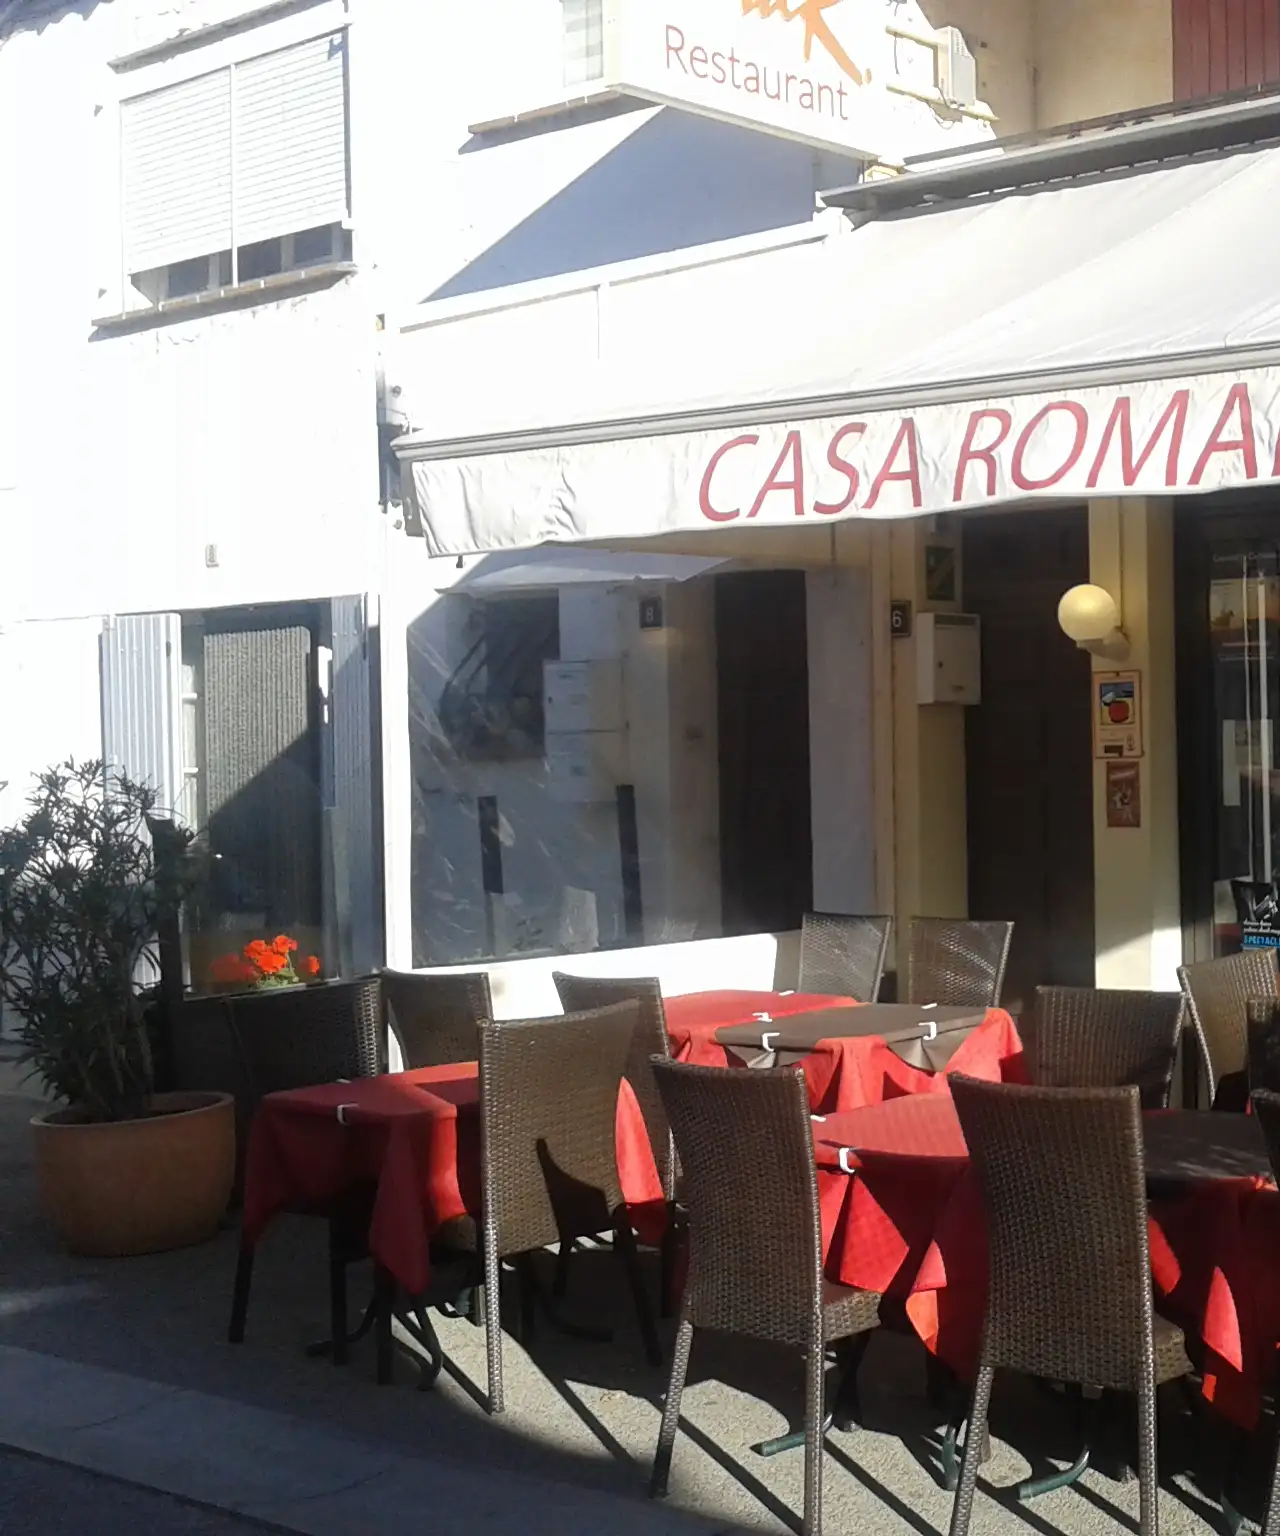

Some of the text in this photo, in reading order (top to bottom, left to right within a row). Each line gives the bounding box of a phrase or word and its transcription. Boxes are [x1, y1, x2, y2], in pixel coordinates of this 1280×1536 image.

[665, 24, 850, 122] Restaurant
[698, 416, 923, 522] CASA
[892, 610, 903, 628] 6
